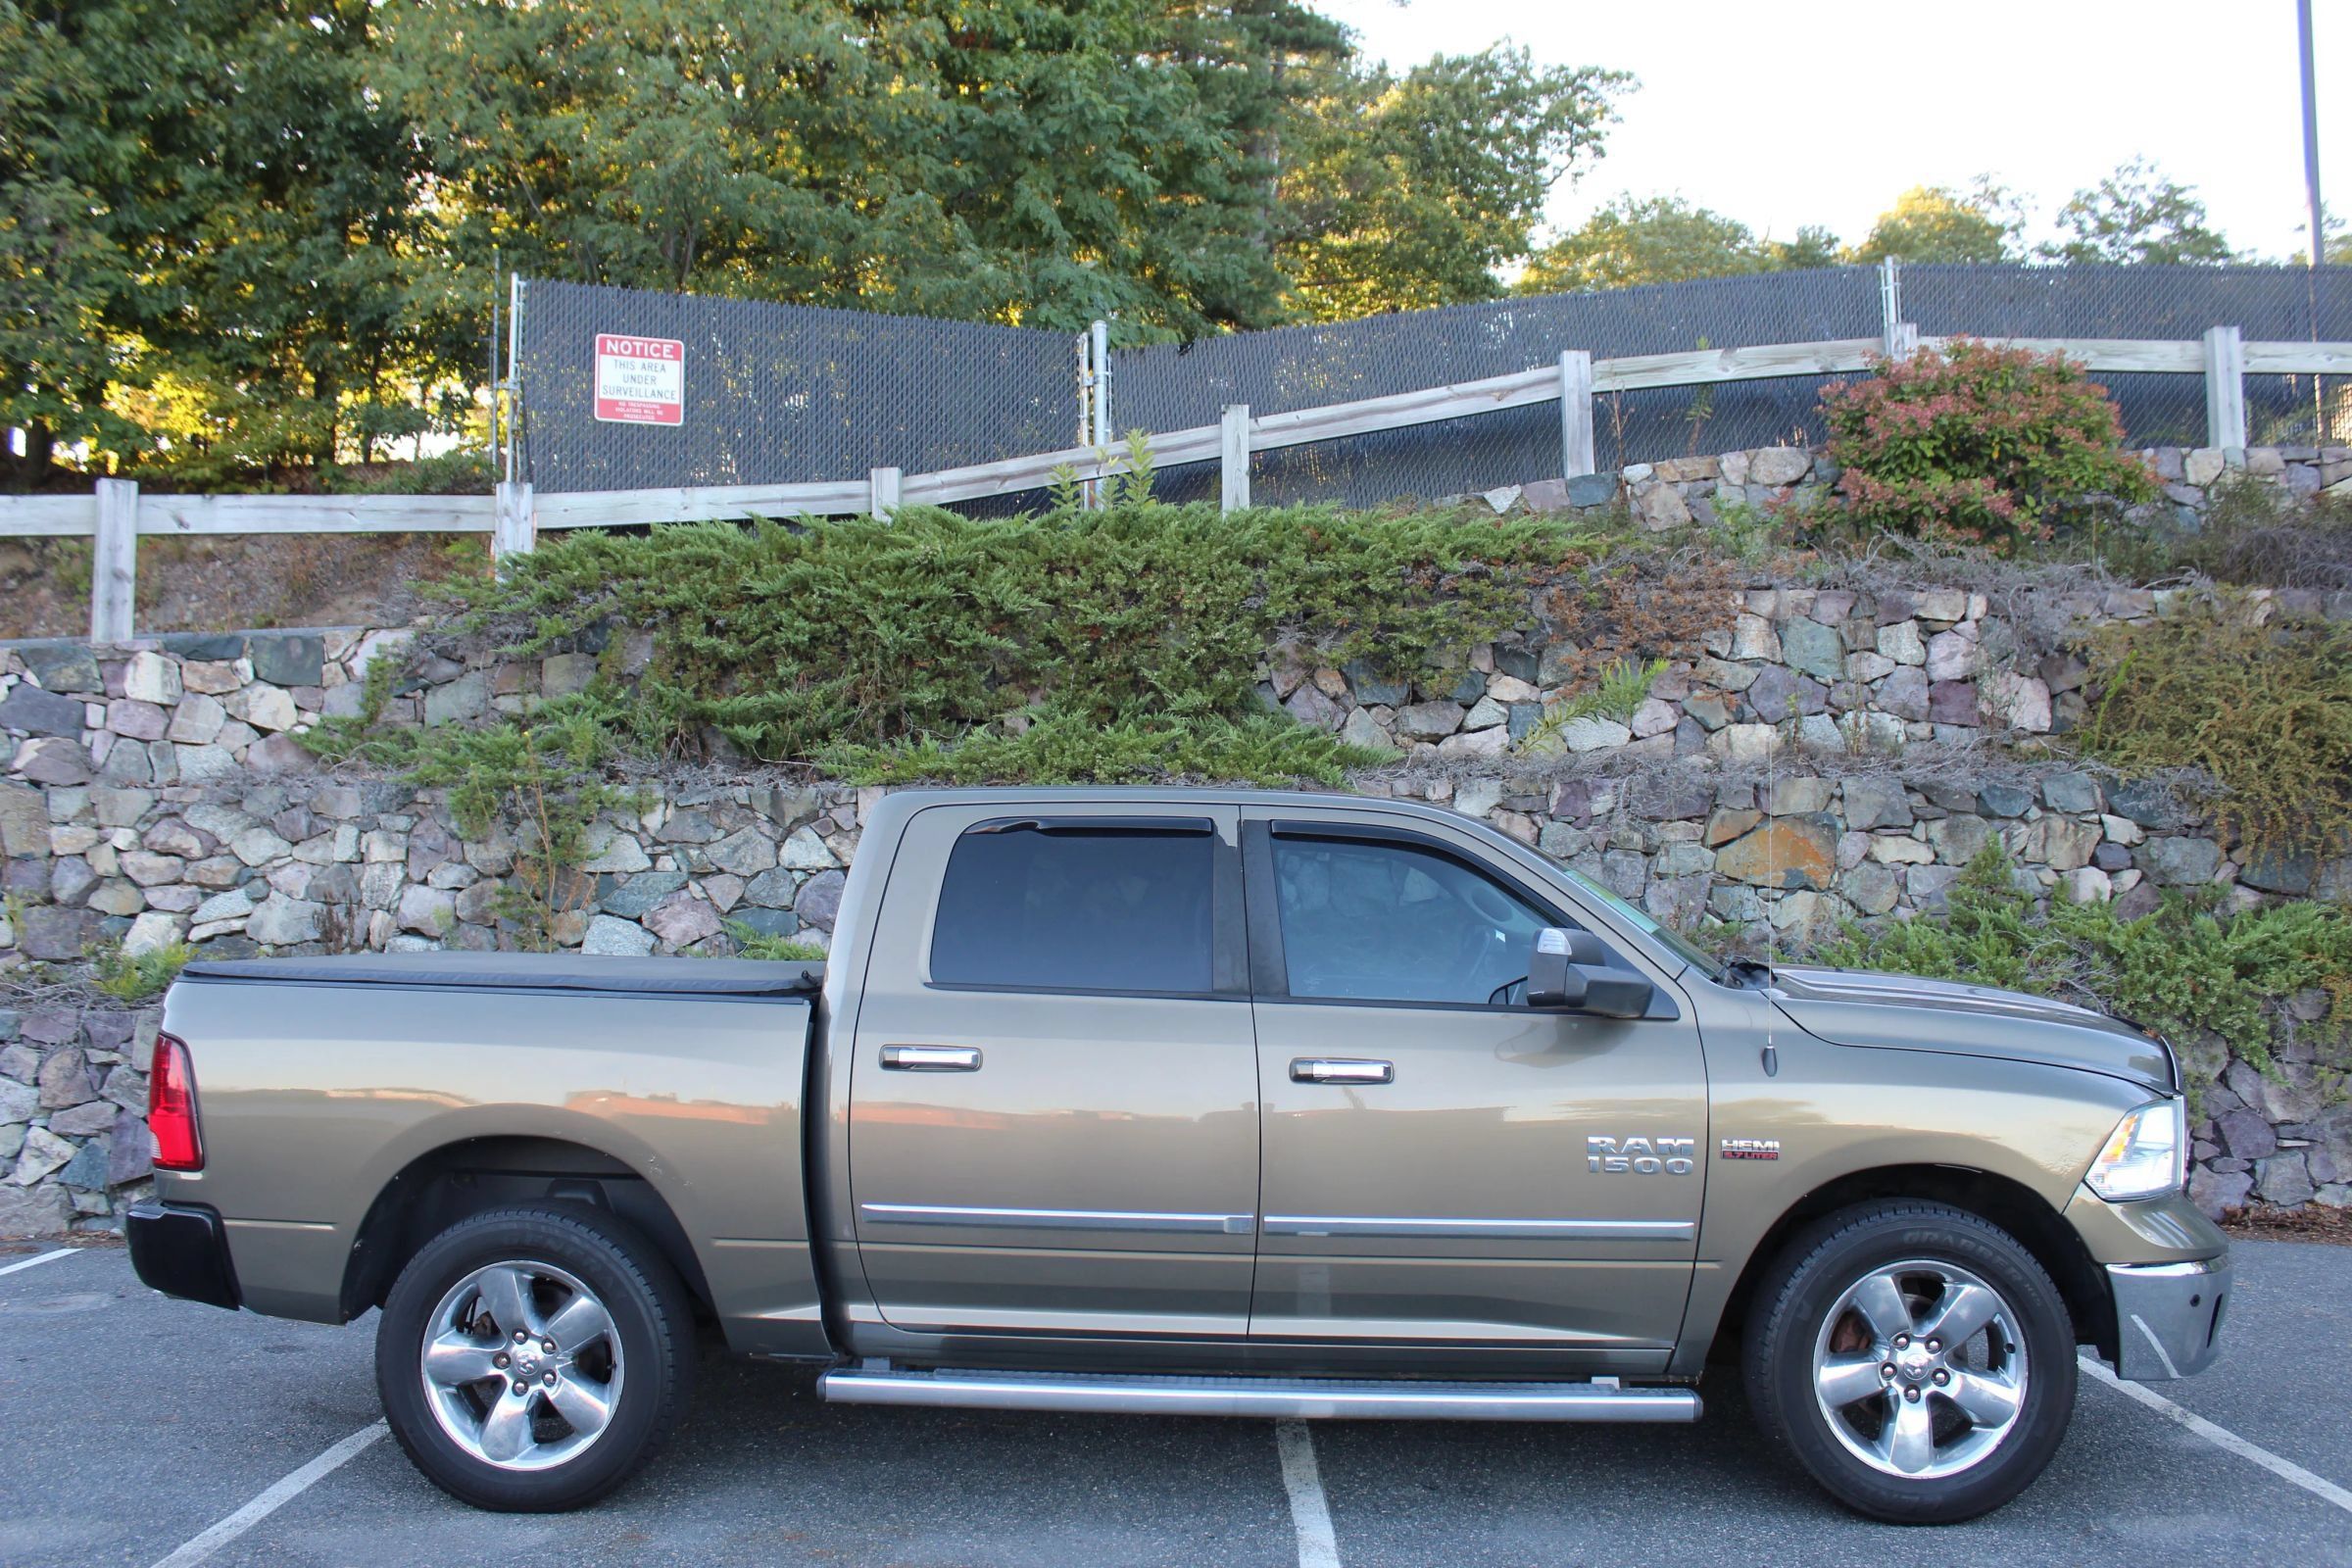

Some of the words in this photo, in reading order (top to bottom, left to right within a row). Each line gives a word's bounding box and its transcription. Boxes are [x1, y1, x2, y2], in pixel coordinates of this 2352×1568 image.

[606, 339, 674, 359] NOTICE
[613, 359, 636, 370] THIS
[641, 362, 666, 373] AREA
[622, 374, 658, 385] UNDER
[602, 385, 676, 401] SURVEILLANCE
[1587, 1136, 1694, 1155] RAM
[1721, 1139, 1780, 1151] HEMI
[1587, 1155, 1693, 1175] 1500
